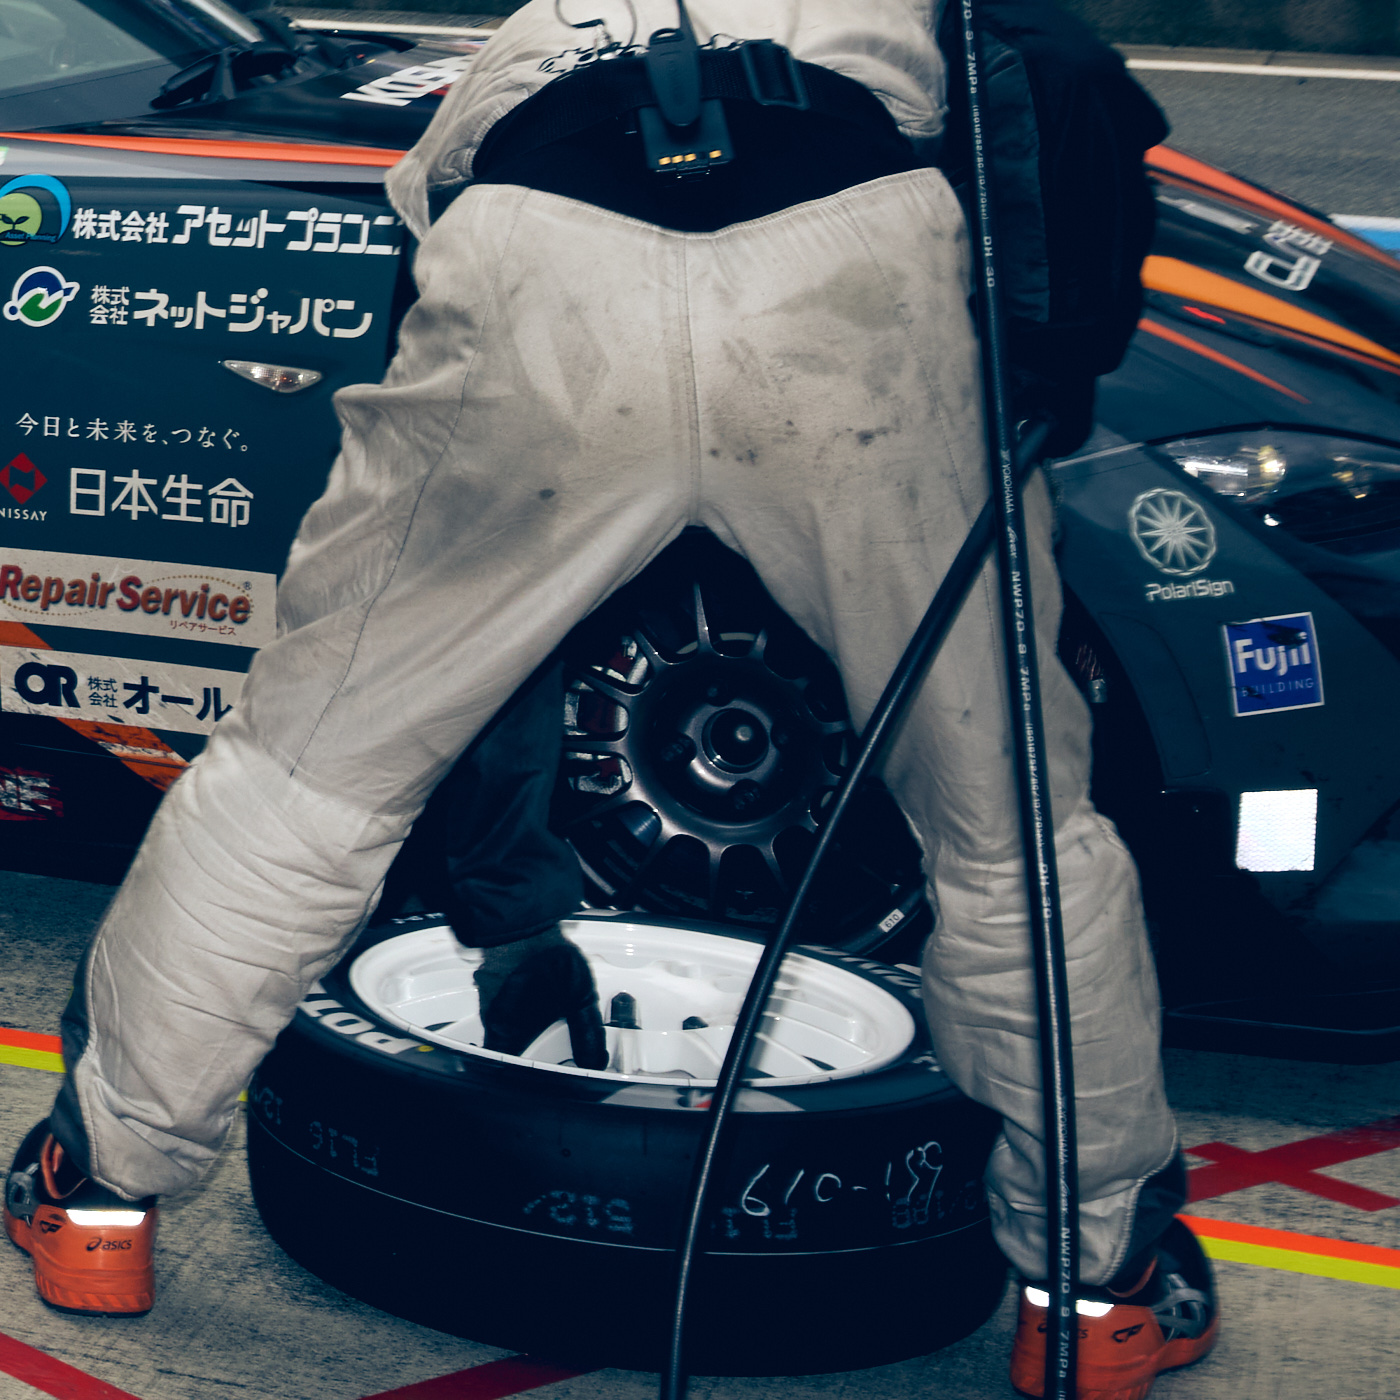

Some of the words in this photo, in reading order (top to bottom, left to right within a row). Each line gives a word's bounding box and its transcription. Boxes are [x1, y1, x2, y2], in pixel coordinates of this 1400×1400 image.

[967, 52, 977, 93] 7MPa
[983, 236, 992, 256] DH
[986, 266, 995, 287] 30
[91, 284, 129, 305] 株式
[89, 304, 129, 325] 会社
[133, 287, 374, 339] ネットジャパン
[15, 412, 249, 453] 今日と未来を、つなぐ。
[70, 467, 254, 528] 日本生命
[1002, 464, 1014, 513] YOKOHAMA
[1011, 571, 1025, 632] NWP70
[1020, 665, 1031, 711] 7MPa
[114, 575, 254, 624] Service
[168, 619, 237, 637] リペアサービス
[86, 675, 118, 693] 株式
[1241, 677, 1315, 697] BUILDING
[86, 691, 119, 709] 会社
[121, 676, 233, 722] オール
[884, 911, 900, 930] 610
[101, 1238, 133, 1251] asics
